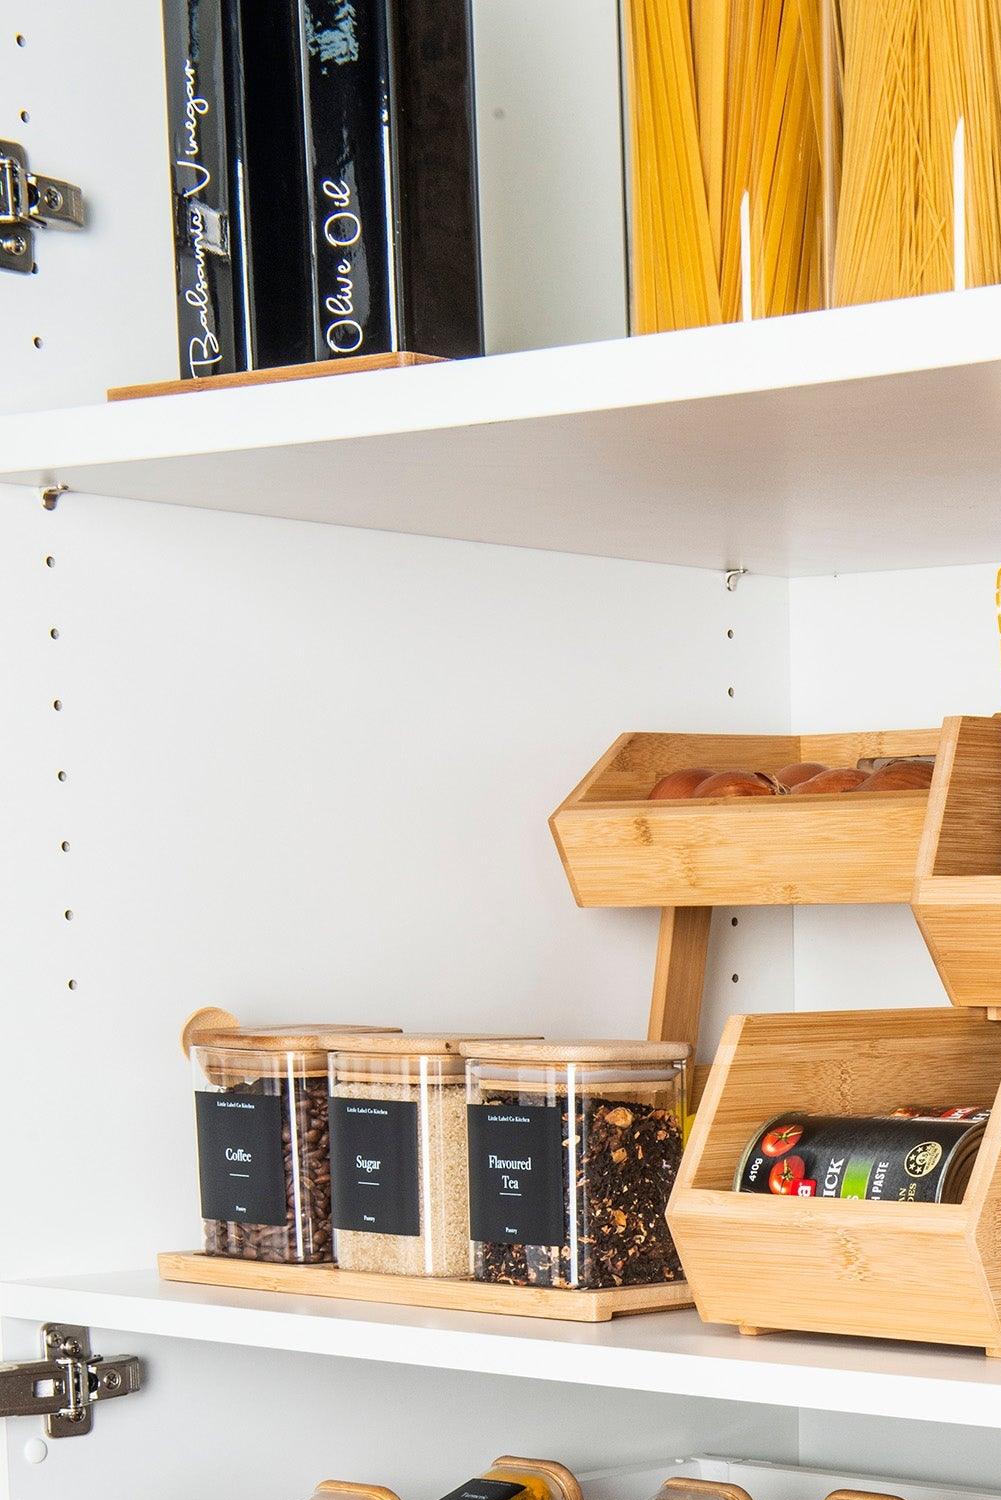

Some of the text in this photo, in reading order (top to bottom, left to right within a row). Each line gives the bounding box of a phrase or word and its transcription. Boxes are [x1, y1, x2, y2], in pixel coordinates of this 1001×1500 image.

[176, 59, 223, 379] Balsamic Vinegar
[322, 179, 364, 353] Olive Oil
[225, 1147, 252, 1163] Coffee
[356, 1154, 381, 1172] Sugar
[488, 1154, 532, 1171] Flavoured
[748, 1156, 764, 1183] 410g
[872, 1161, 890, 1194] PASTE
[501, 1175, 520, 1189] Tea
